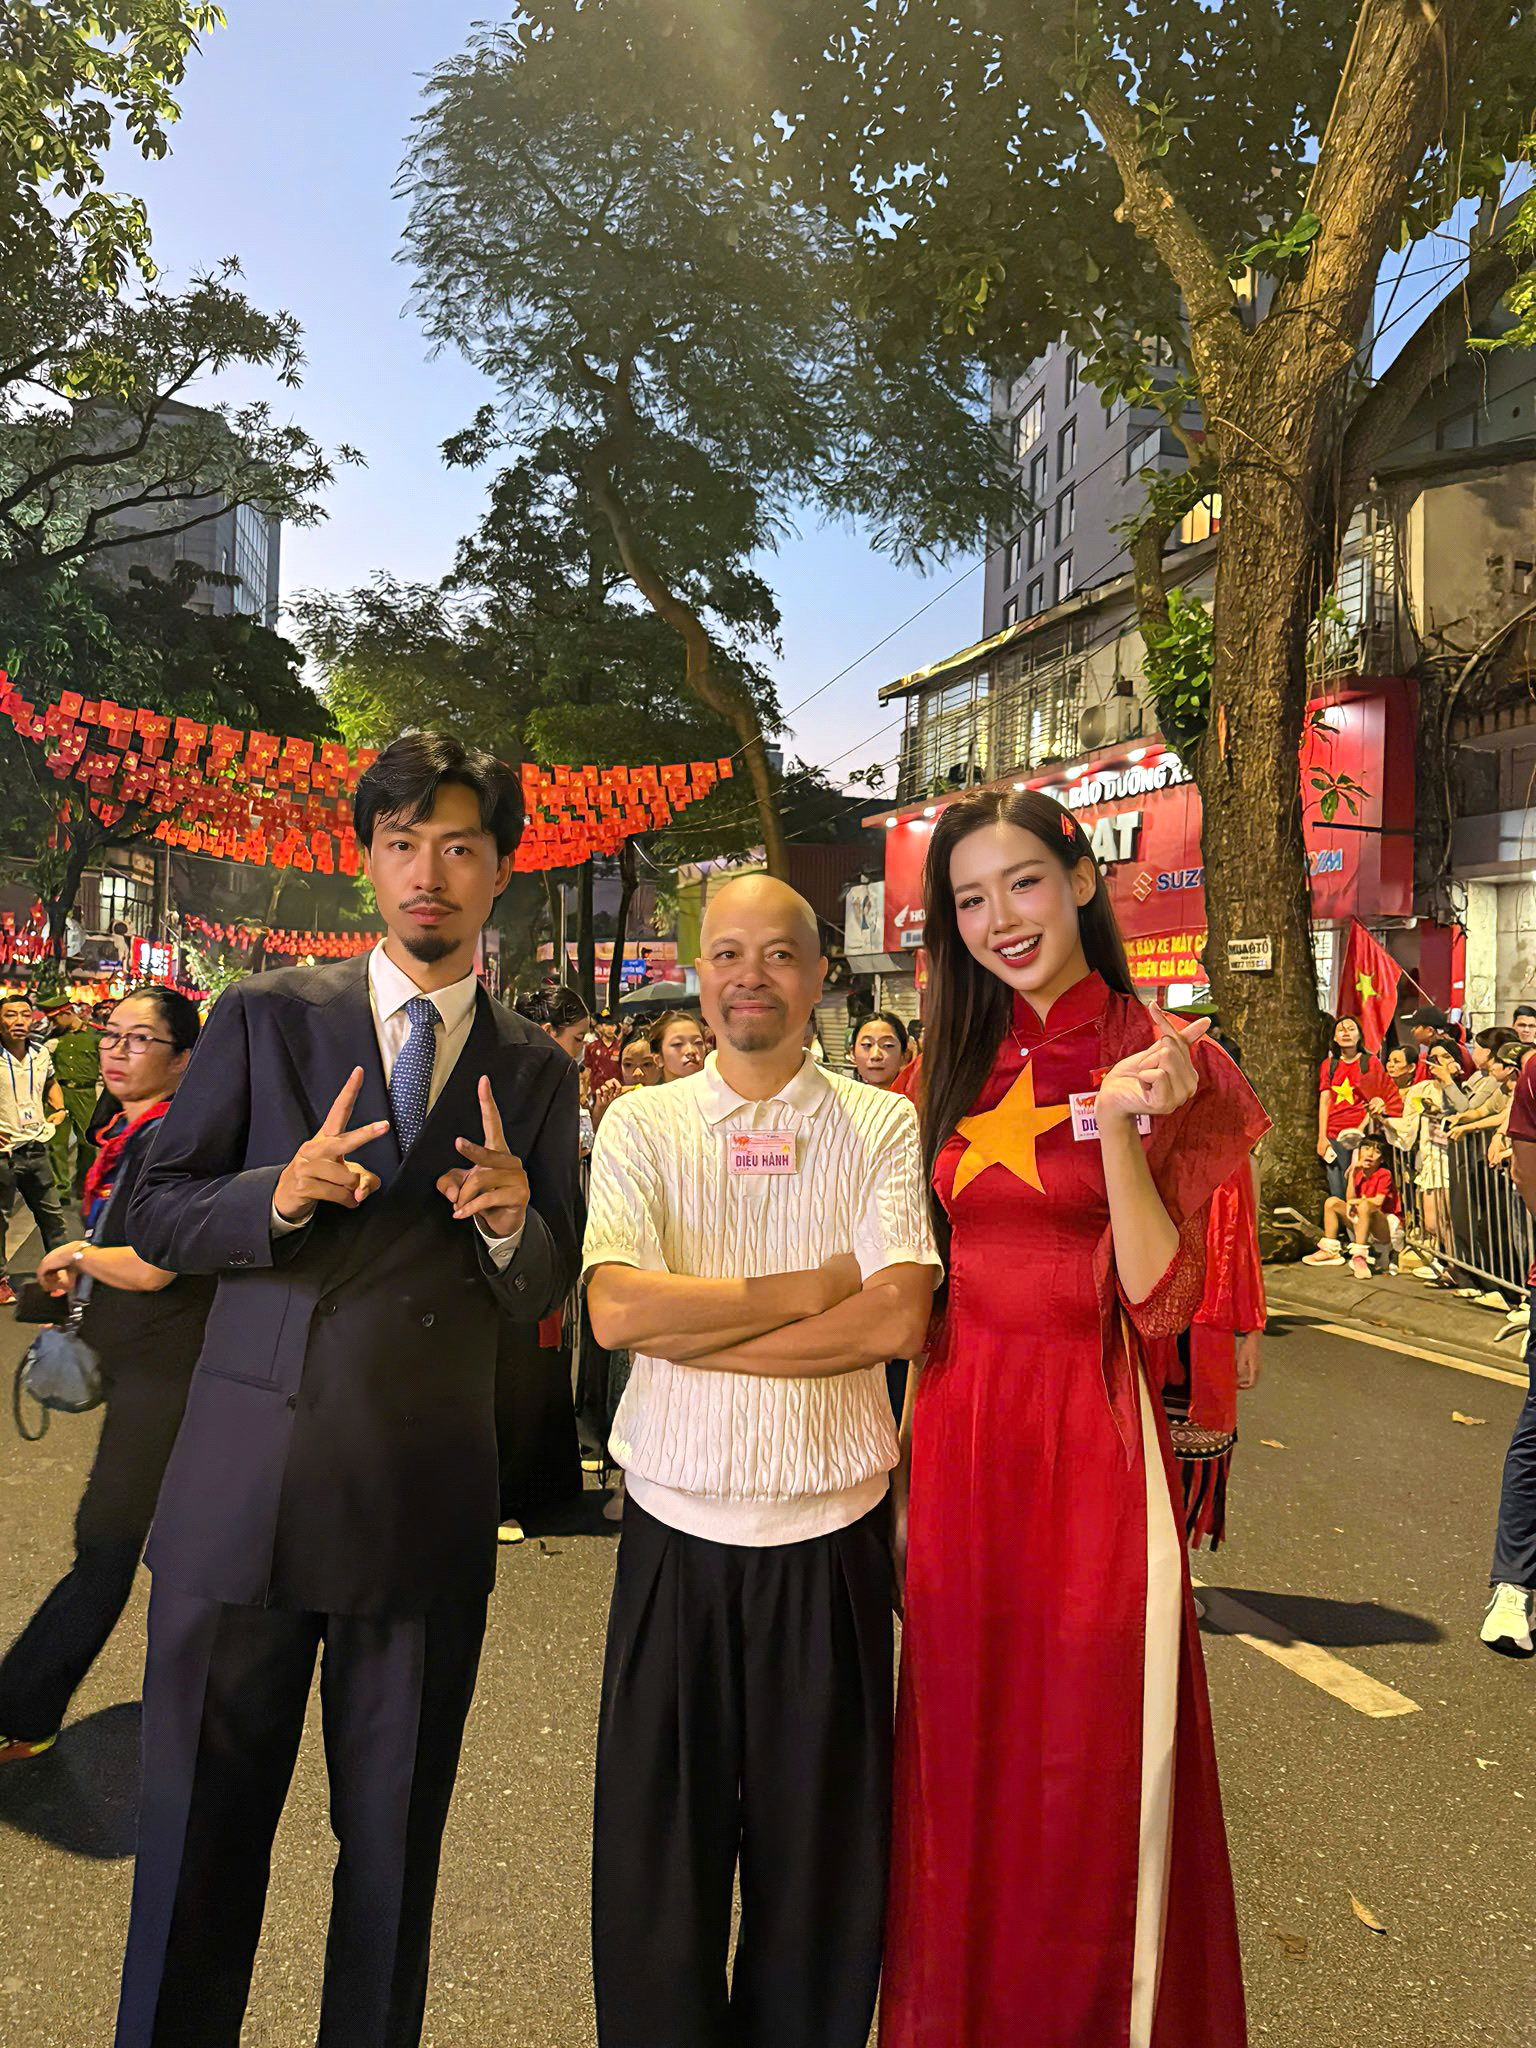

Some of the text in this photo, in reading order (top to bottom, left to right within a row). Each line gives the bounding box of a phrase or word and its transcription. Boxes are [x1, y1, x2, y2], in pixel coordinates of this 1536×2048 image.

[1156, 866, 1204, 892] SUZ
[1177, 959, 1198, 977] CAO
[761, 1152, 789, 1167] HÀNH
